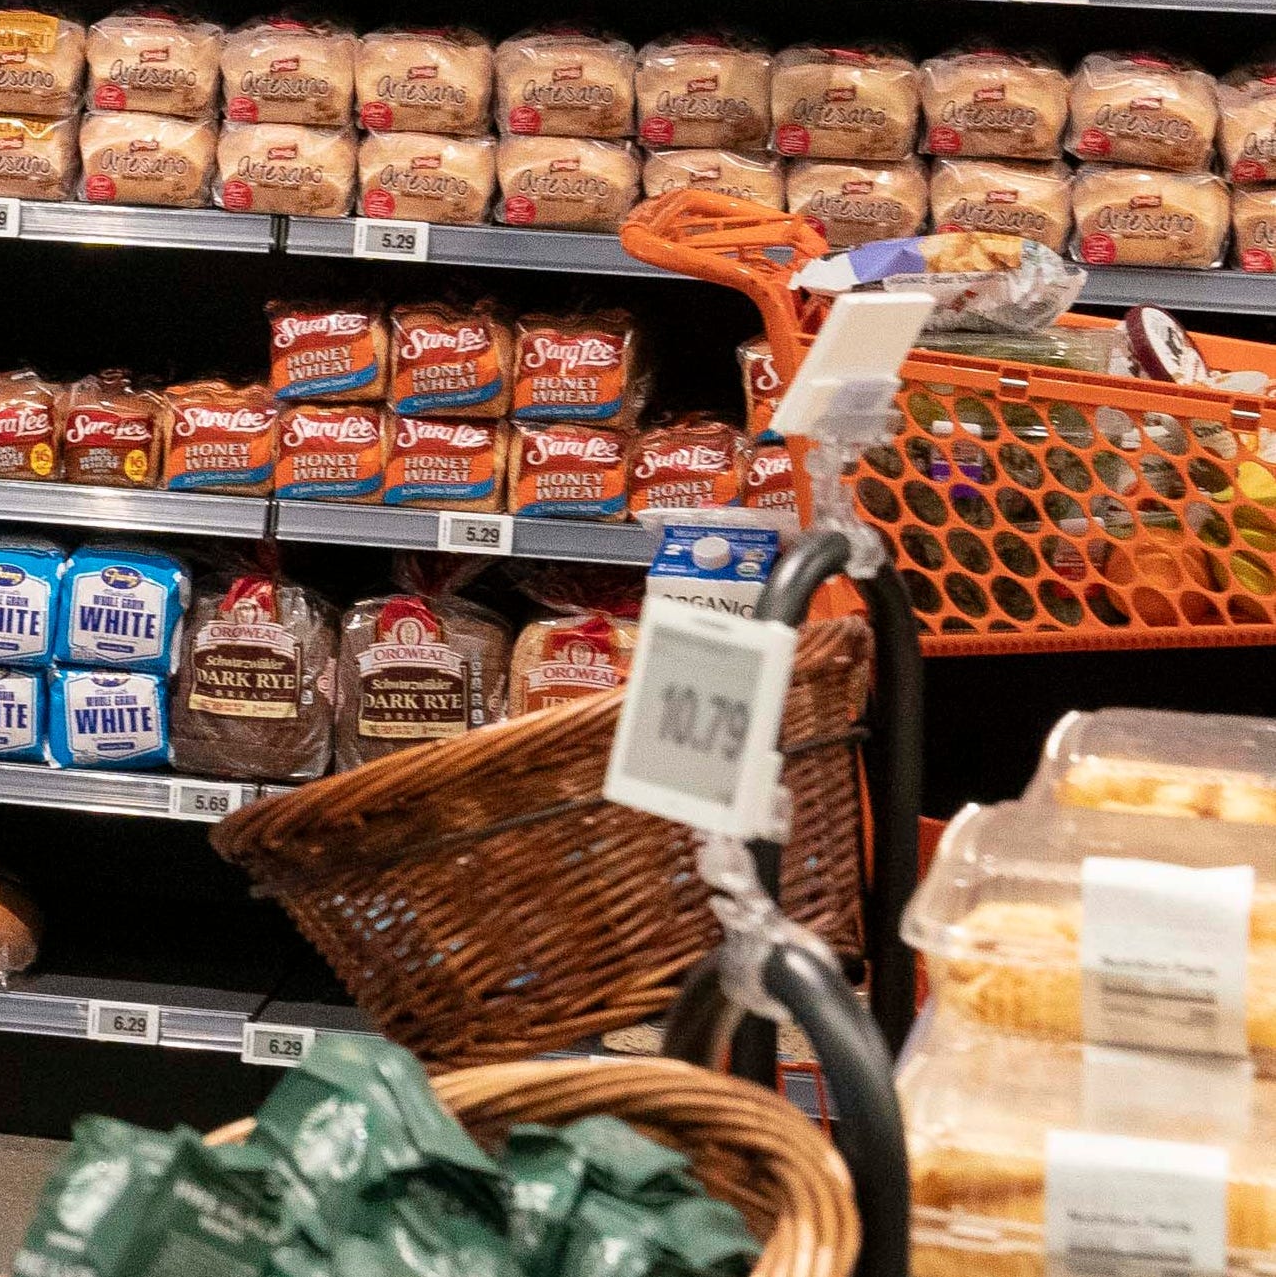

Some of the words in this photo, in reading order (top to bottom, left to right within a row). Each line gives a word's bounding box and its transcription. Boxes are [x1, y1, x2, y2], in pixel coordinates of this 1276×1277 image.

[381, 232, 416, 251] 5.29
[185, 443, 250, 459] HONEY
[292, 452, 359, 468] HONEY
[536, 472, 604, 488] HONEY
[466, 525, 501, 544] 5.29
[80, 605, 156, 639] WHITE
[196, 668, 251, 689] DARK
[256, 671, 297, 690] RYE
[364, 693, 417, 709] DARK
[422, 693, 463, 710] RYE
[195, 794, 228, 812] 5.69
[113, 1016, 147, 1034] 6.29
[269, 1039, 303, 1057] 6.29
